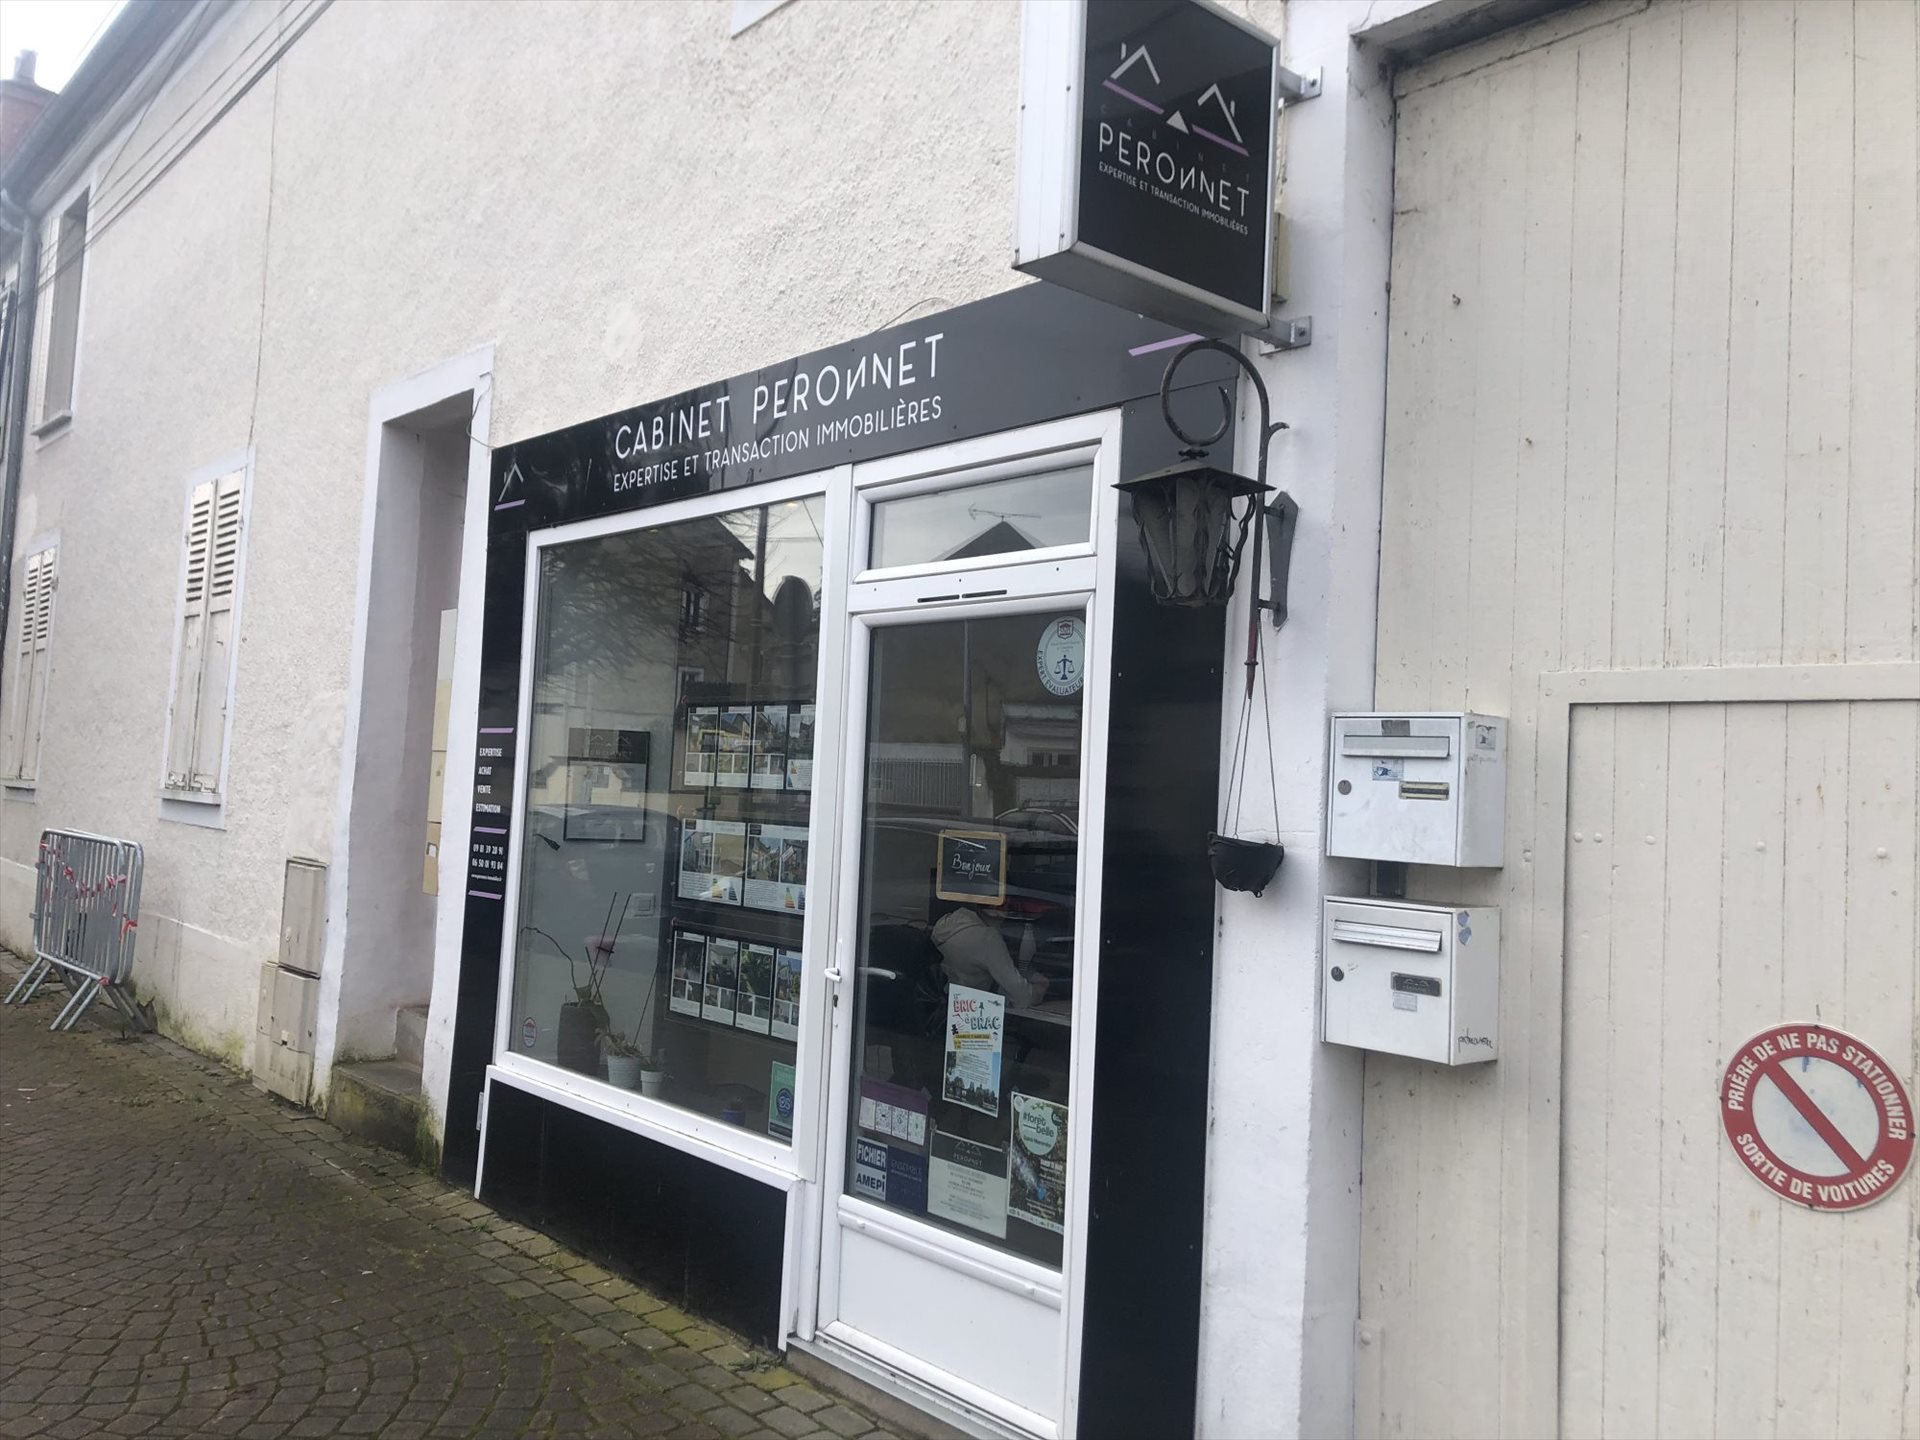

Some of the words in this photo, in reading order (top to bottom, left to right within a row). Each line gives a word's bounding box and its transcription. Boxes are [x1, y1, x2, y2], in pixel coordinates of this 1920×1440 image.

[1098, 161, 1137, 188] EXPERTISE
[1139, 180, 1149, 193] ET
[1151, 185, 1200, 216] TRANSACTION
[615, 395, 731, 460] CABINET
[613, 459, 679, 493] EXPERTISE
[683, 454, 699, 477] ET
[704, 427, 810, 472] TRANSACTION
[816, 395, 943, 446] IMMOBILIÈRES
[479, 747, 503, 757] EXPERTISE
[478, 766, 492, 776] ACHAT
[477, 784, 491, 794] VENTE
[475, 803, 501, 813] ESTIMATION
[951, 853, 992, 881] Bonjour
[953, 999, 977, 1013] BRIC
[970, 1015, 1001, 1031] BRAC
[1728, 1055, 1757, 1111] PRIÈRE
[1752, 1040, 1777, 1062] DE
[1776, 1032, 1801, 1051] NE
[1806, 1032, 1840, 1055] PAS
[1842, 1045, 1907, 1141] STATIONNER
[856, 1142, 887, 1170] FICHIER
[1736, 1132, 1788, 1187] SORTIE
[1789, 1176, 1814, 1199] DE
[1816, 1158, 1895, 1203] VOITURES
